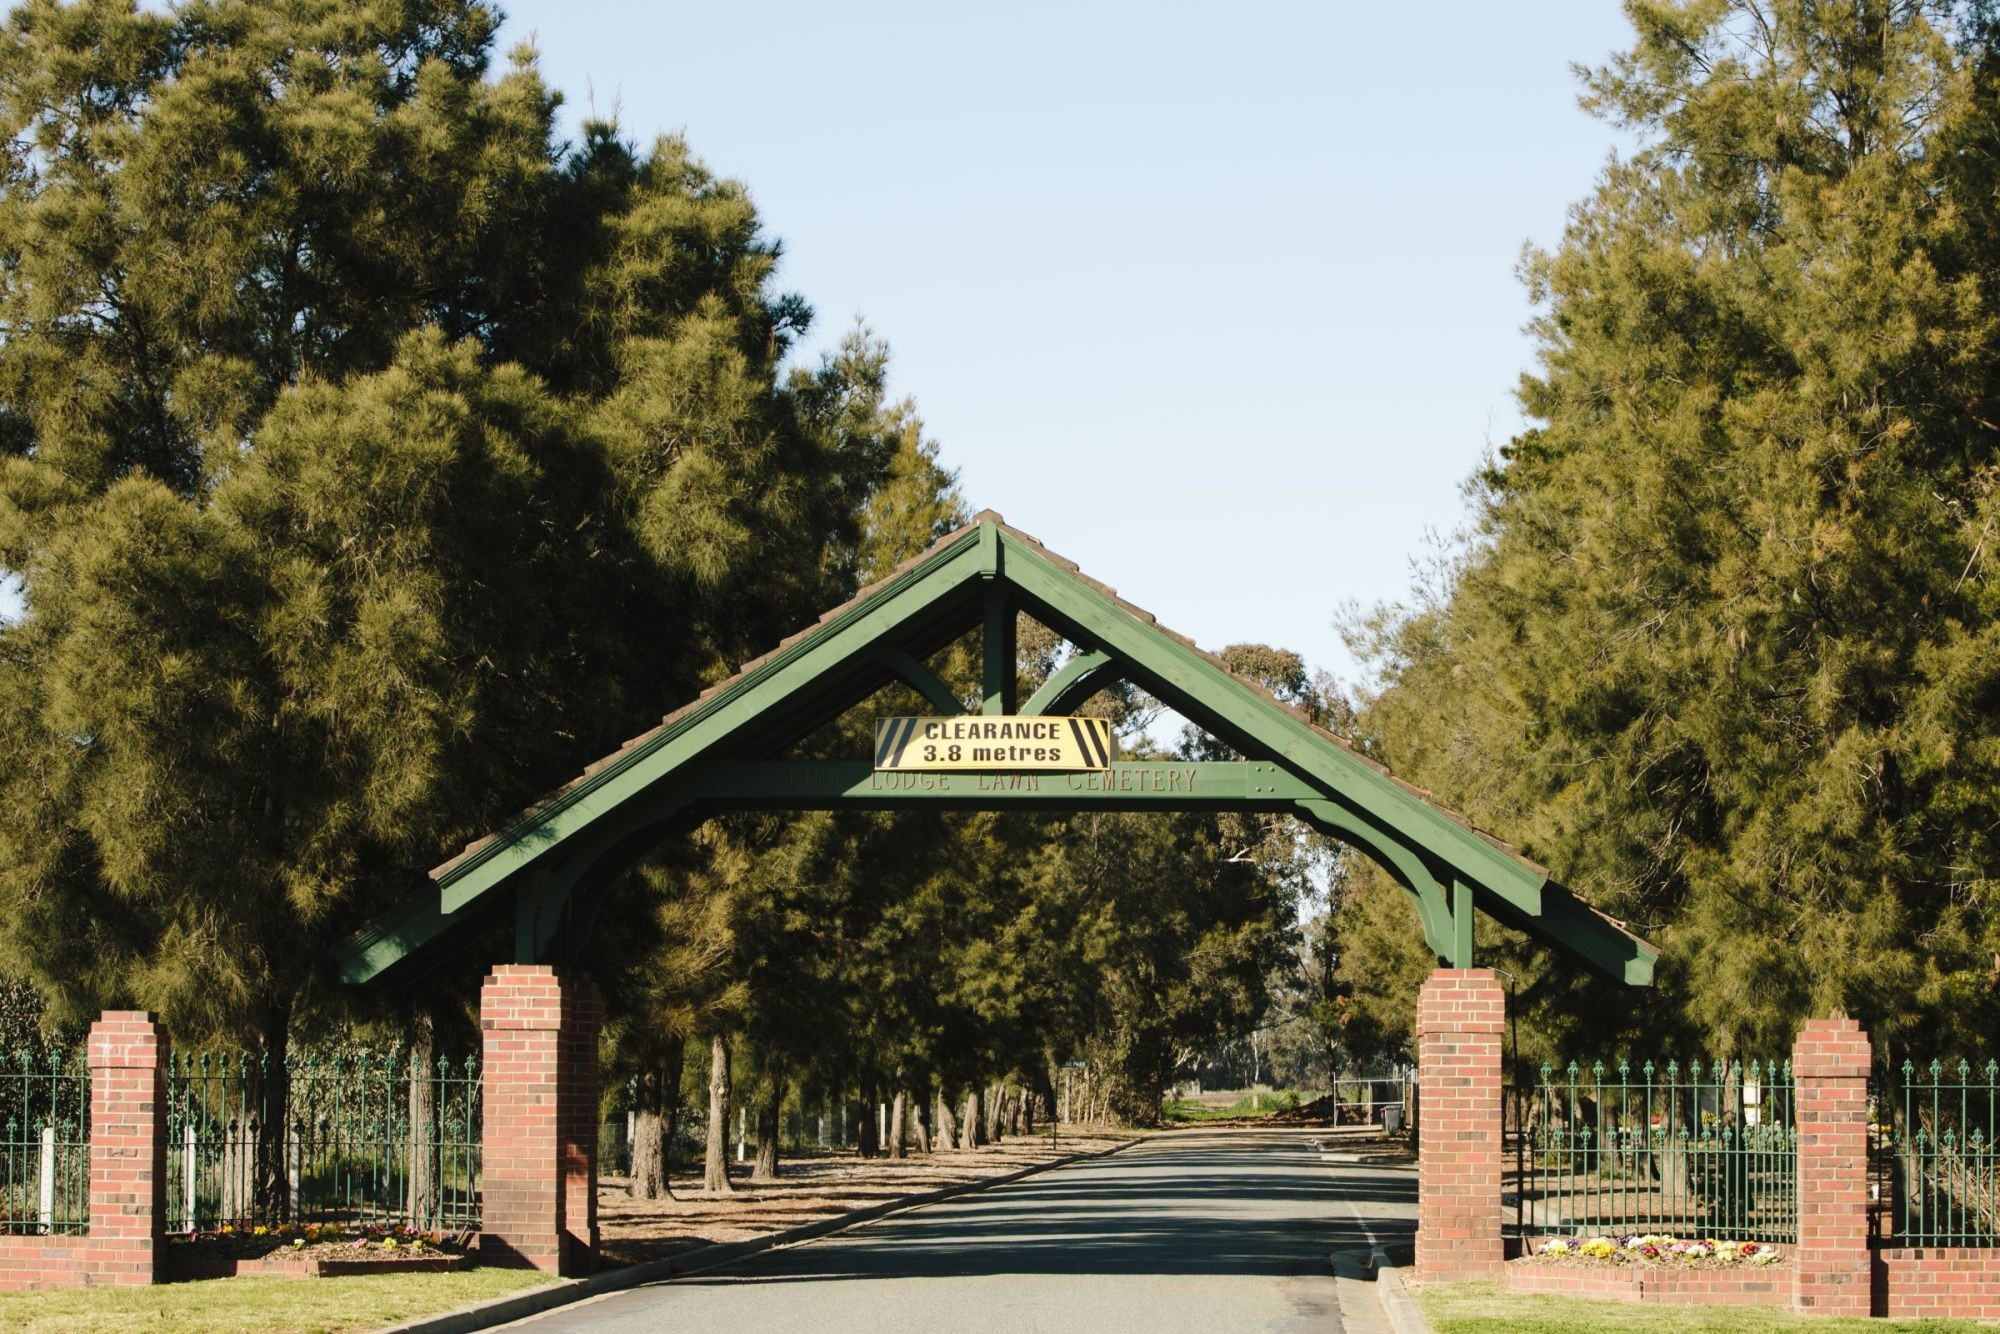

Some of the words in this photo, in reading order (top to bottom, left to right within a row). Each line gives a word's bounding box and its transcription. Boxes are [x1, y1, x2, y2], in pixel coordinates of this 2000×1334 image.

[924, 722, 1061, 740] CLEARANCE
[923, 744, 962, 762] 3.8
[972, 745, 1061, 762] metres
[870, 771, 950, 790] LODGE
[977, 771, 1039, 791] LAWN
[1067, 769, 1197, 791] CEMETERY
